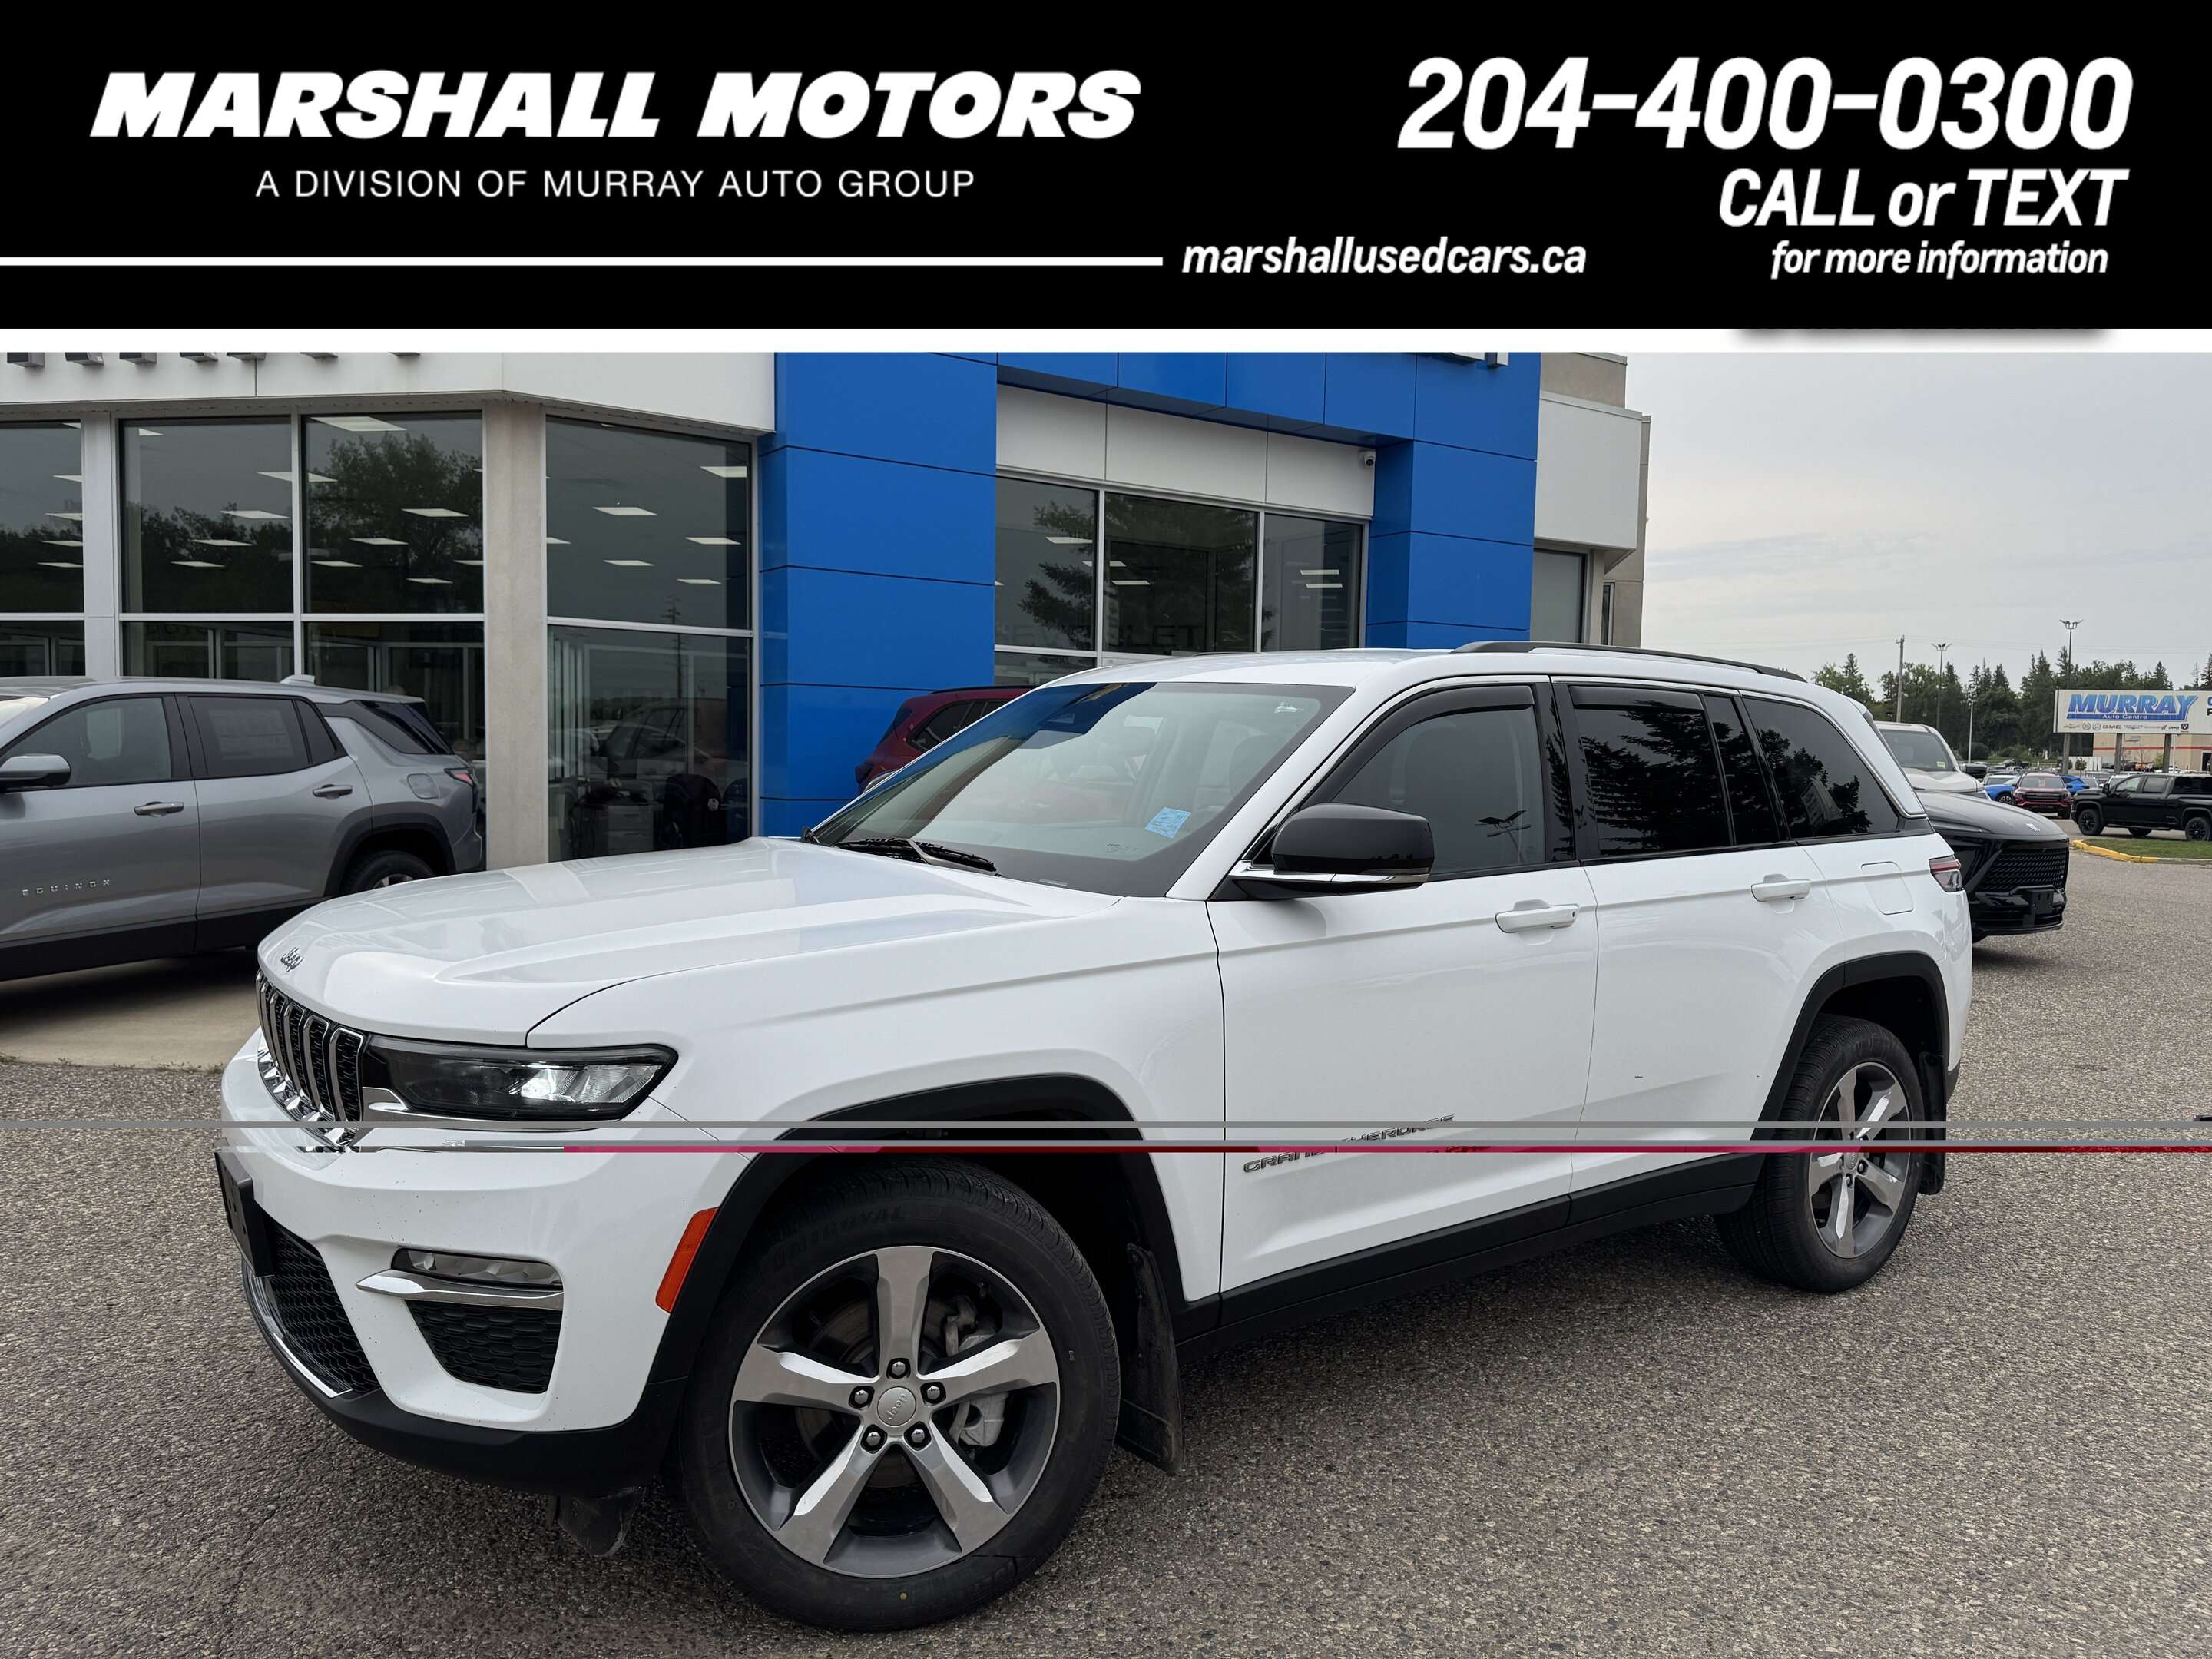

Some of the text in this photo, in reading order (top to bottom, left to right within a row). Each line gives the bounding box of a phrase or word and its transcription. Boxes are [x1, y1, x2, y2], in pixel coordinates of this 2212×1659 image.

[2068, 694, 2198, 715] MURRAY
[22, 879, 110, 896] EQUINOX
[886, 1392, 909, 1420] Jeep
